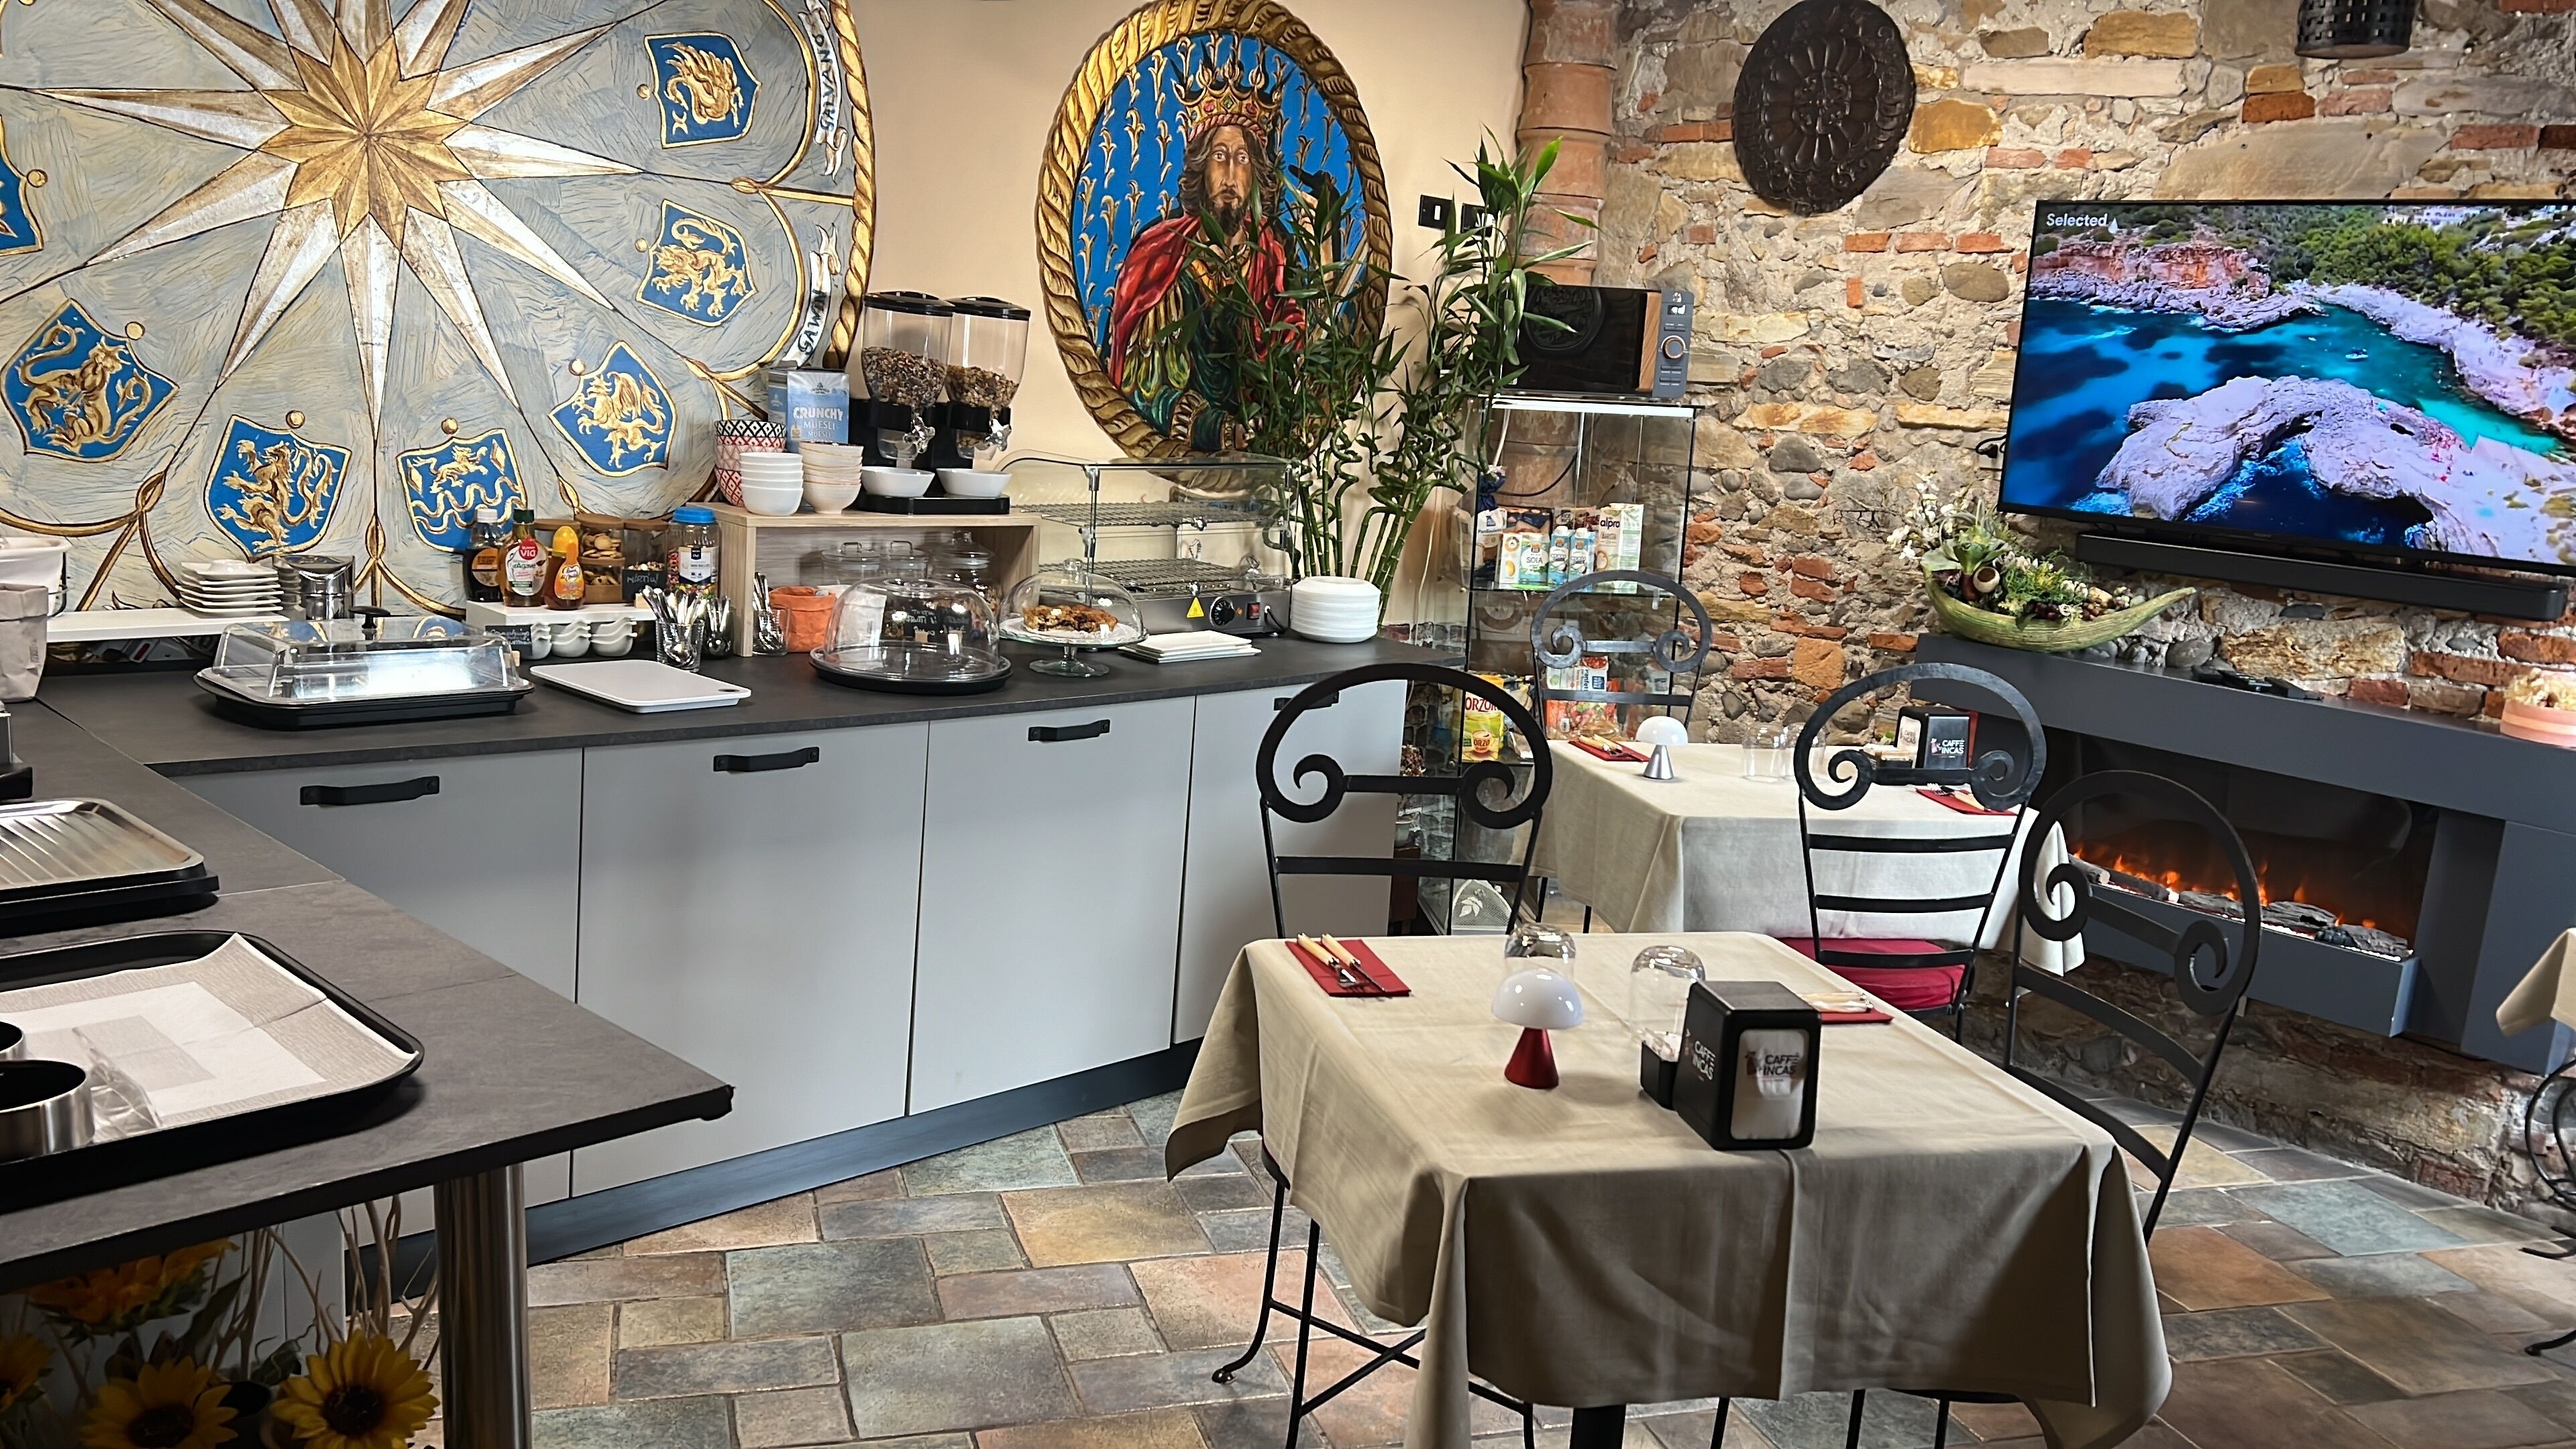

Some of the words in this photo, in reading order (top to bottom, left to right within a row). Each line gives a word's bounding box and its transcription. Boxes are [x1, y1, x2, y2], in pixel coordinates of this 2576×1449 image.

[812, 34, 835, 131] GALVANO
[2046, 213, 2108, 227] Selected
[794, 407, 843, 421] CRUNCHY
[804, 421, 835, 429] MUESLI
[1600, 517, 1620, 529] alpro
[1473, 739, 1491, 747] ORZO
[1941, 747, 1964, 755] INCAS
[1763, 1065, 1796, 1076] INCAS
